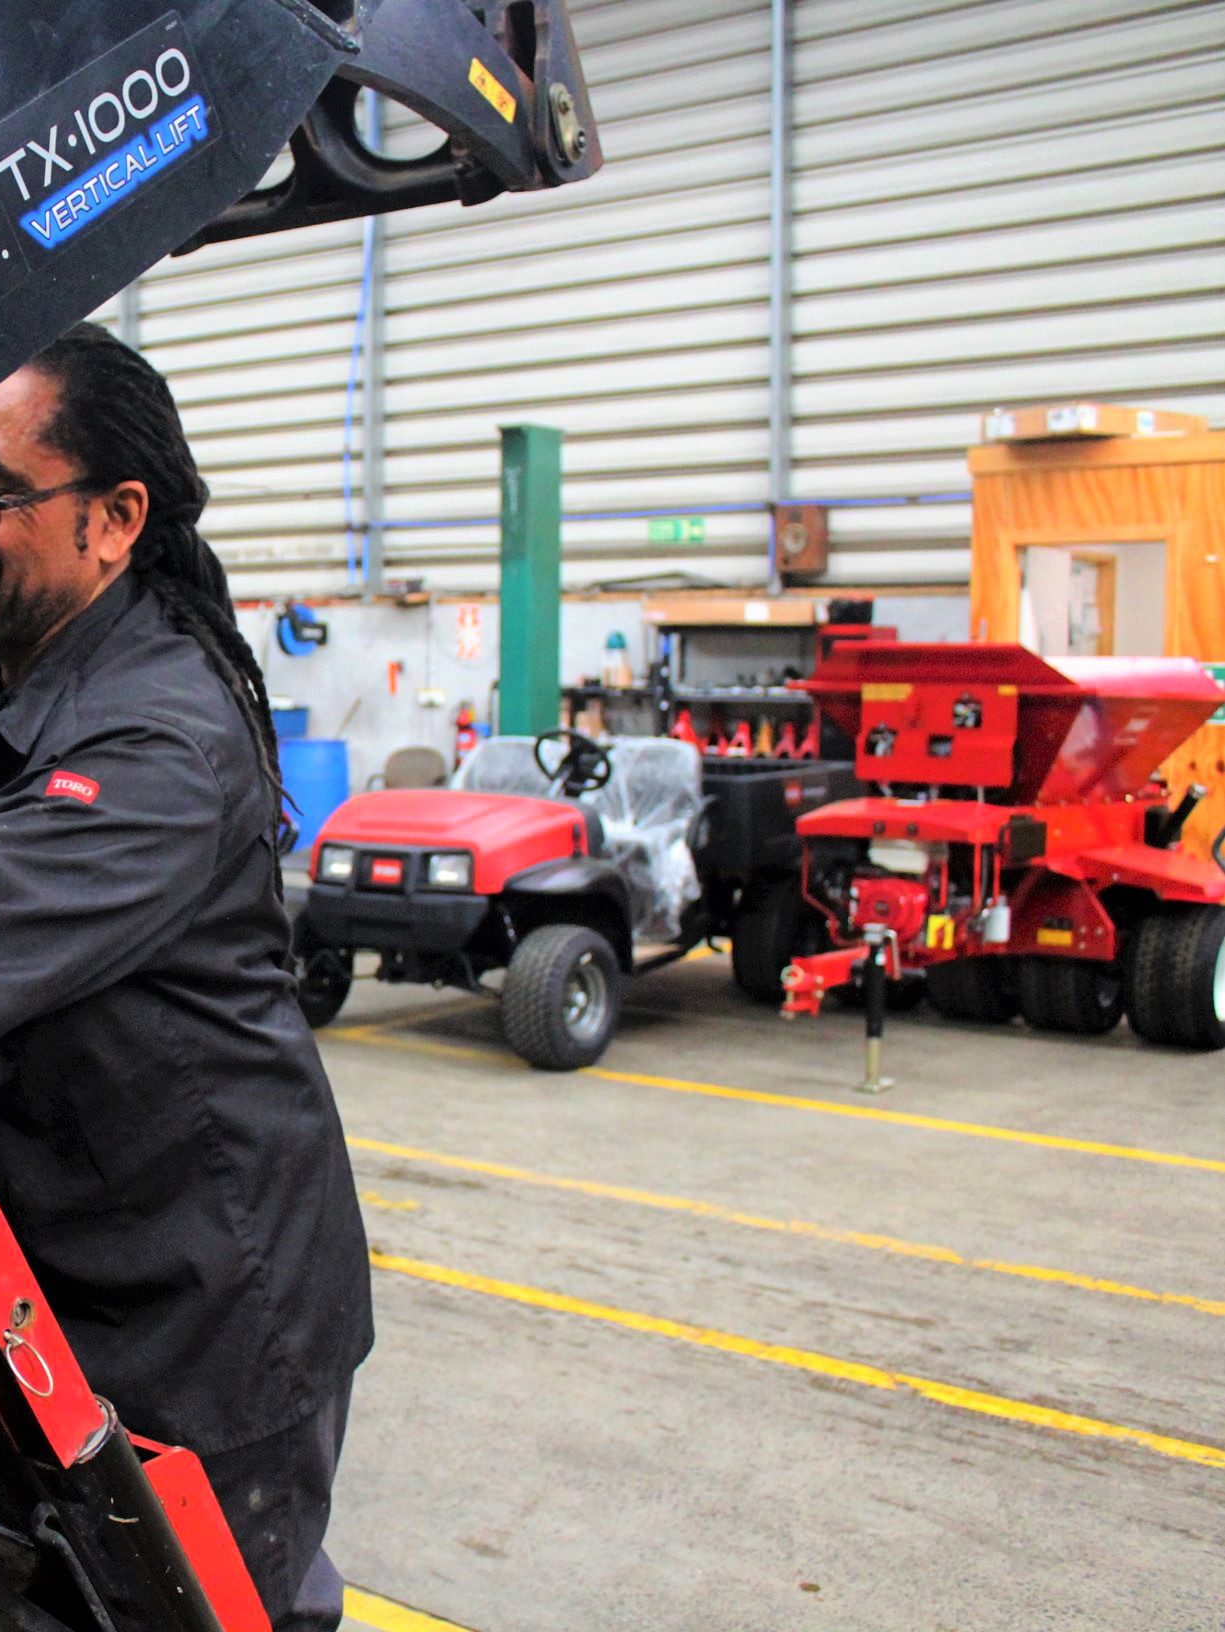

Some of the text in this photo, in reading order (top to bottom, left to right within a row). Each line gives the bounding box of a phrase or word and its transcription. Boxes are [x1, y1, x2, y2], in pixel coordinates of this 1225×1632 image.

[31, 103, 207, 241] VERTICAL LIFT
[54, 779, 93, 796] TORO
